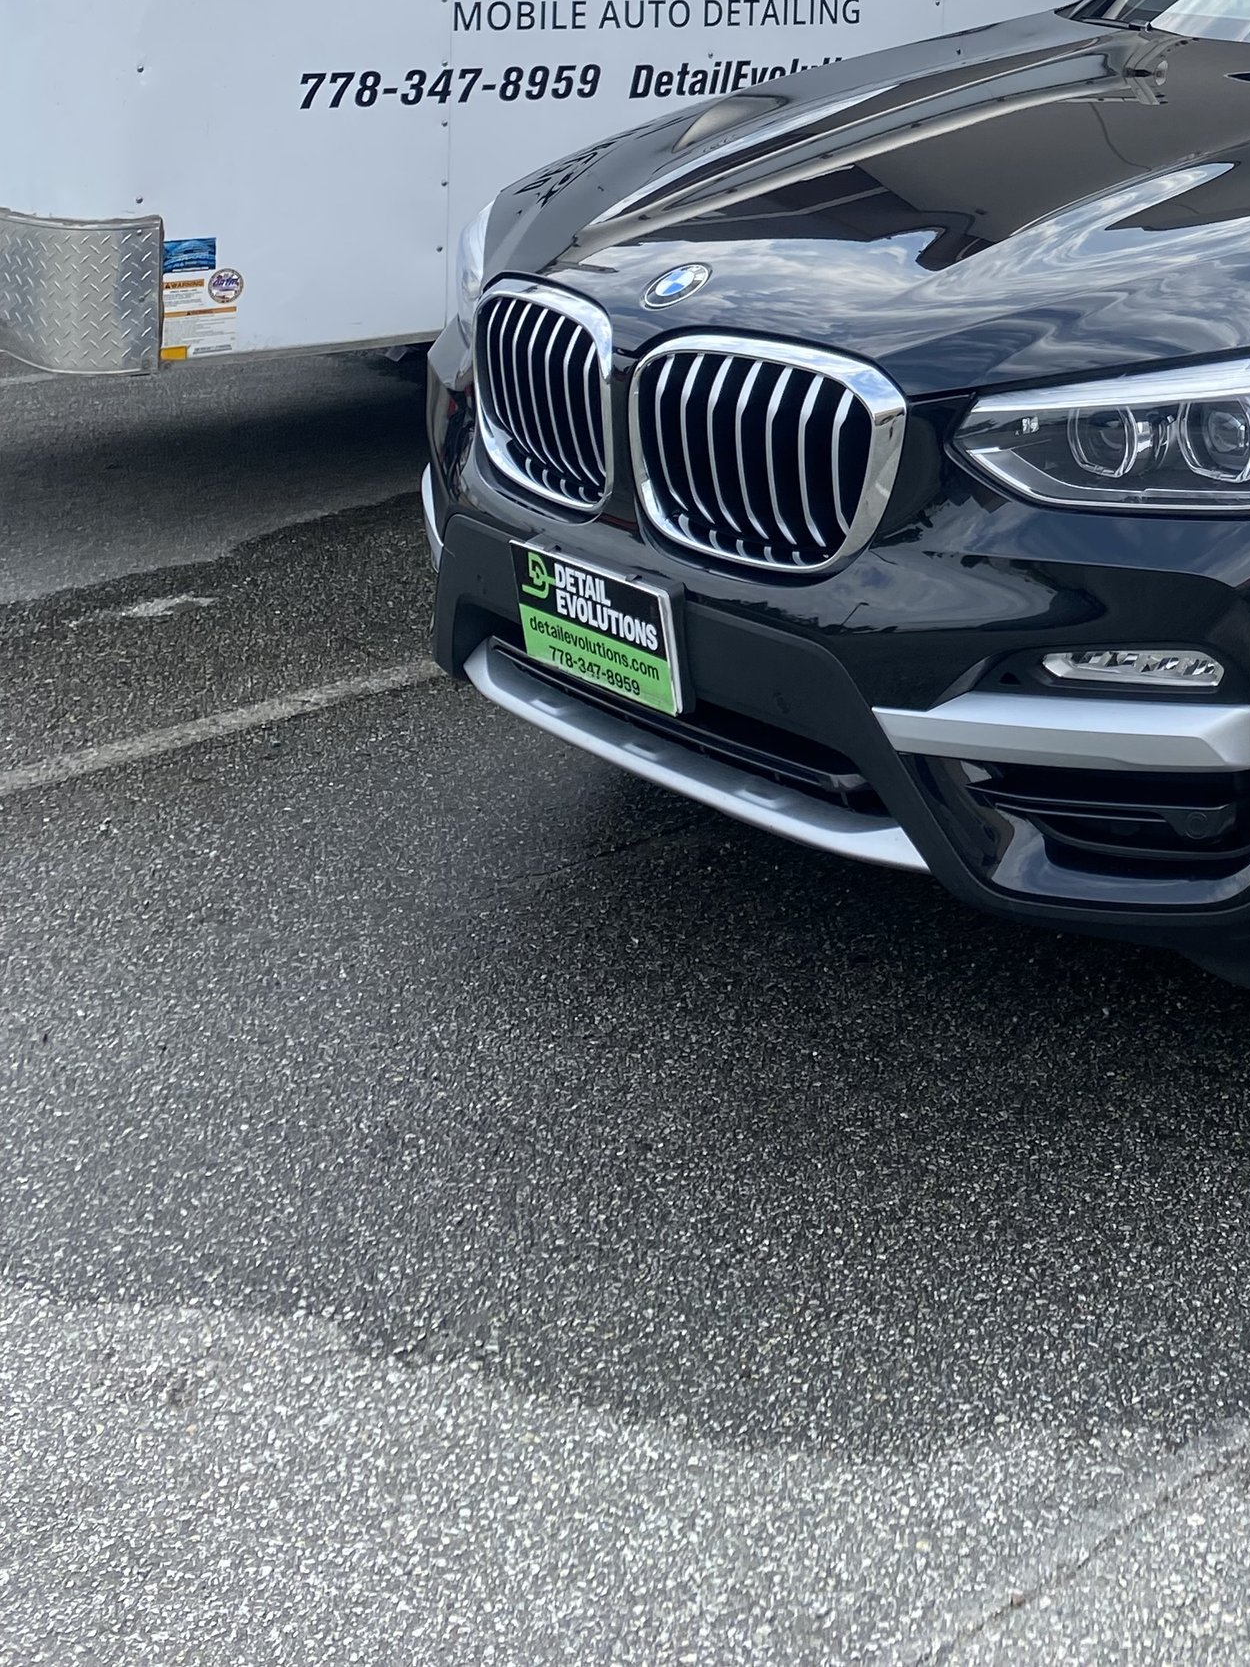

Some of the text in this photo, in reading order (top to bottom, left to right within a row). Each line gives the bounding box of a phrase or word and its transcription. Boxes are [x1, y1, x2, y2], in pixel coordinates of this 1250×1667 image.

[453, 0, 587, 32] MOBILE
[598, 0, 691, 30] AUTO
[299, 63, 601, 110] 778-347-8959
[554, 562, 611, 607] DETAIL
[555, 588, 658, 651] EVOLUTIONS
[529, 616, 660, 681] detailevolutions.com
[548, 645, 641, 696] 778-347-8959
